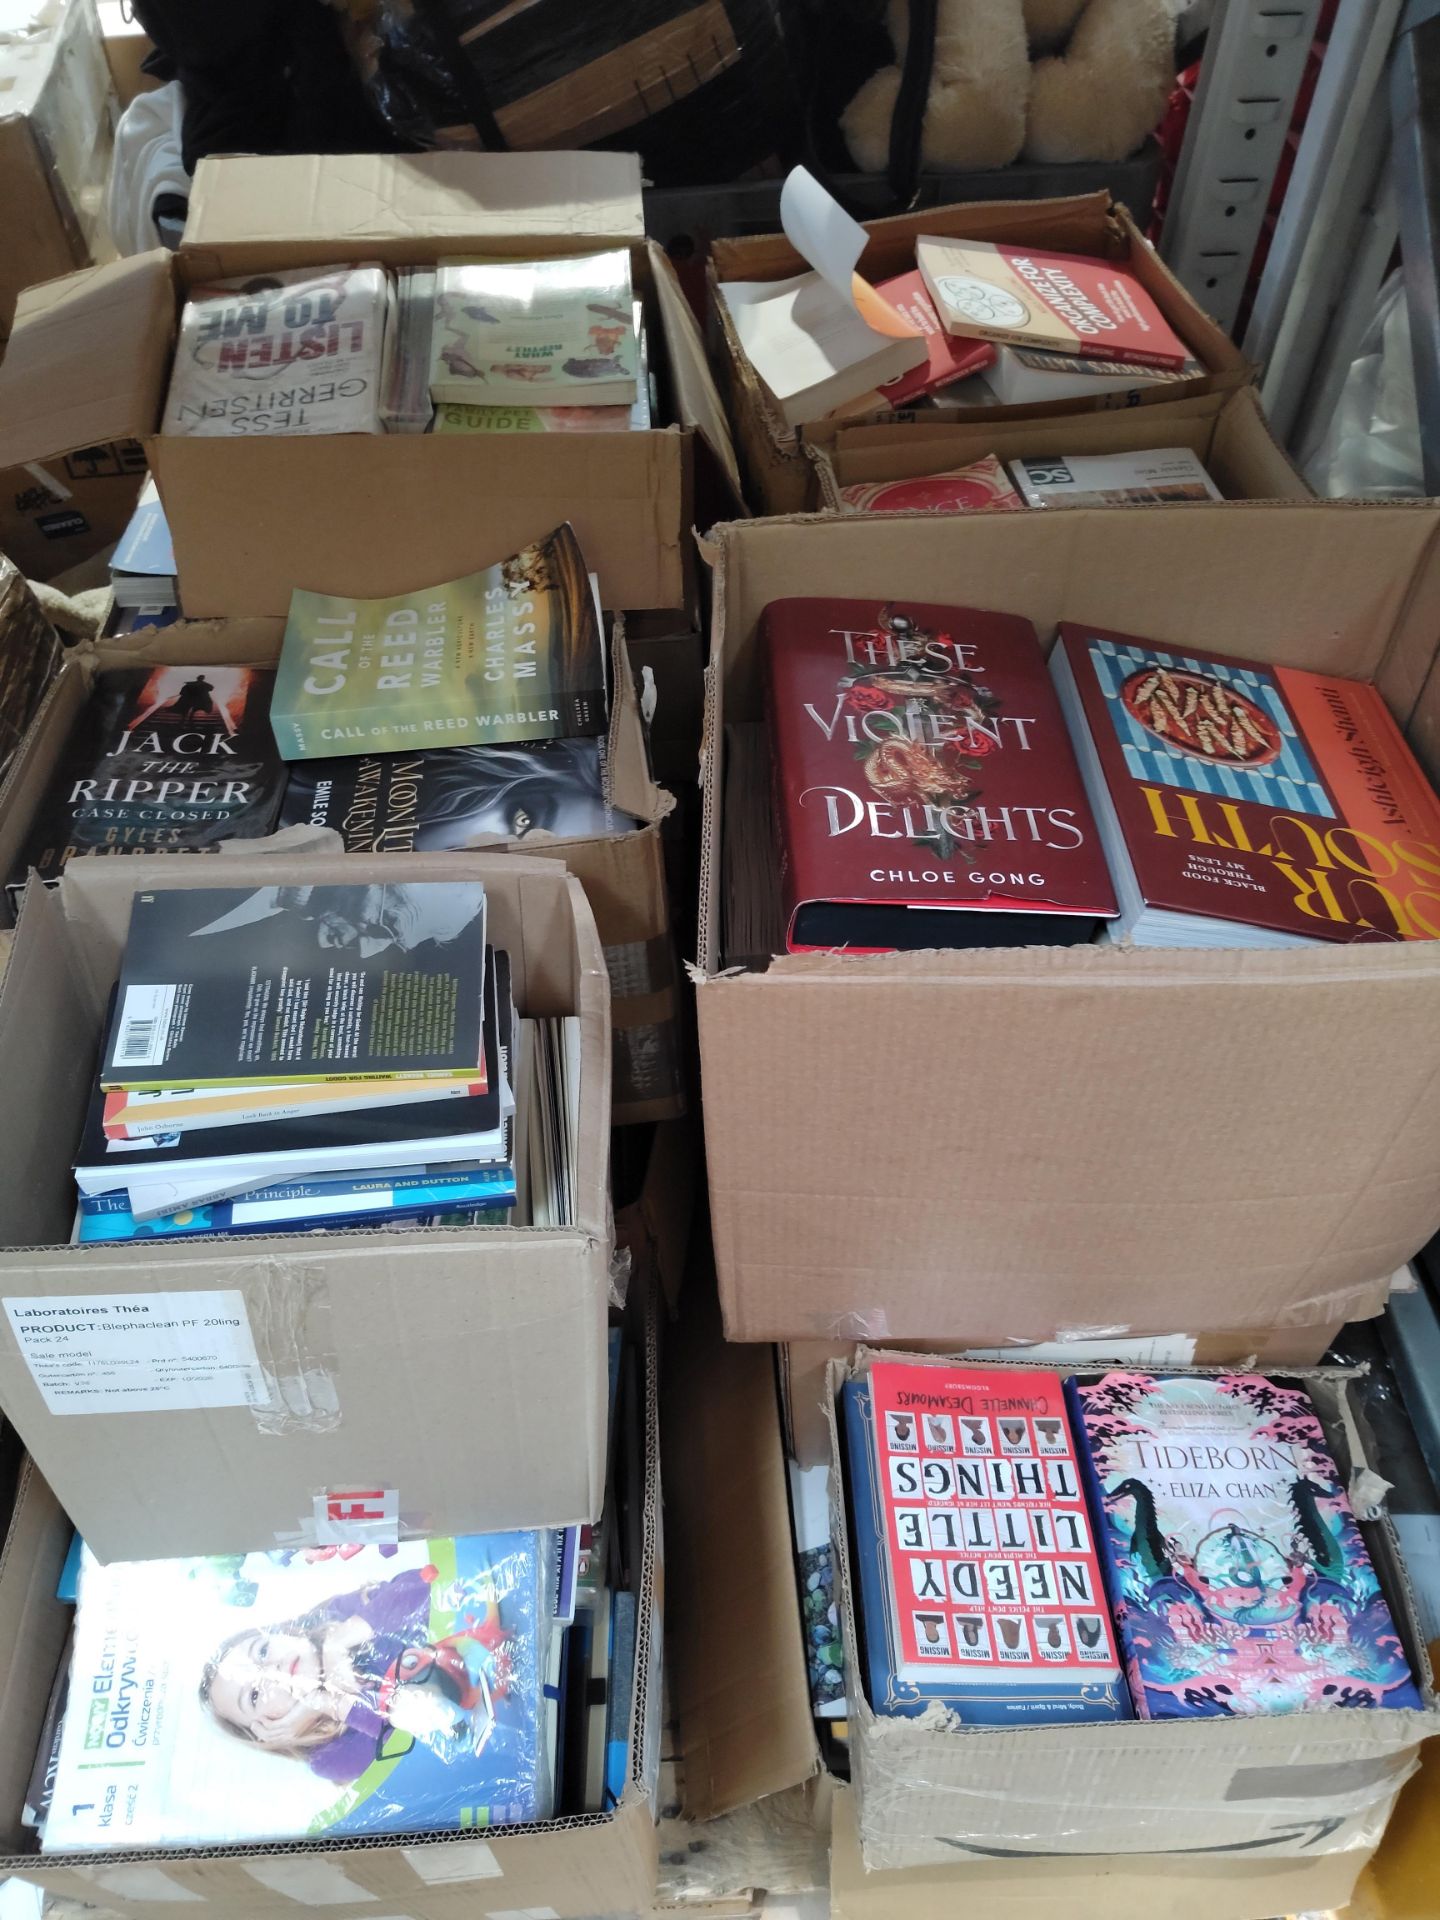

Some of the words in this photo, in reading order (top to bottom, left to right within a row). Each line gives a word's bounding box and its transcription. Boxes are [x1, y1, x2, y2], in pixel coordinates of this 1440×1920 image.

[1010, 256, 1037, 284] FOR
[1034, 275, 1099, 335] ORGANIZE
[1042, 266, 1118, 331] COMPLEXITY
[197, 303, 271, 343] ME
[284, 294, 336, 329] TO
[217, 320, 364, 373] LISTEN
[514, 350, 554, 359] WHAT
[176, 378, 367, 421] GERRITSEN
[232, 408, 309, 435] TESS
[443, 412, 532, 430] GUIDE
[1028, 468, 1071, 485] SC
[484, 587, 506, 682] CHARLES
[508, 579, 538, 679] MASSY
[304, 609, 357, 696] CALL
[359, 656, 370, 669] OF
[366, 633, 376, 653] THE
[376, 608, 420, 690] REED
[420, 601, 447, 689] WARBLER
[829, 628, 987, 674] THESE
[321, 727, 366, 740] CALL
[371, 726, 385, 736] OF
[391, 723, 417, 734] THE
[423, 717, 470, 732] REED
[474, 709, 560, 728] WARBLER
[803, 692, 1037, 752] VIOLENT
[106, 730, 240, 757] JACK
[295, 722, 306, 751] MASSY
[142, 760, 200, 774] THE
[67, 777, 252, 804] RIPPER
[313, 780, 332, 810] EMILE
[71, 808, 129, 819] CASE
[138, 809, 231, 821] CLOSED
[799, 785, 1084, 852] DELIGHTS
[105, 825, 183, 844] GYLES
[1139, 786, 1440, 890] SOUTH
[1188, 854, 1223, 867] LENS
[1188, 862, 1255, 882] THROUGH
[1227, 859, 1246, 871] MY
[869, 869, 956, 885] CHLOE
[968, 871, 1046, 887] GONG
[1182, 870, 1222, 885] FOOD
[1226, 878, 1267, 893] BLACK
[137, 1123, 153, 1132] John
[155, 1121, 184, 1130] Osborne
[352, 1182, 391, 1191] LAURA
[394, 1179, 419, 1188] AND
[422, 1175, 469, 1185] DUTTON
[90, 1199, 130, 1212] The
[244, 1184, 317, 1202] Principle
[14, 1306, 108, 1318] Laboratoires
[115, 1304, 150, 1314] Théa
[20, 1323, 102, 1334] PRODUCT:
[102, 1321, 179, 1332] Blephaclean
[182, 1319, 199, 1328] PF
[24, 1336, 53, 1344] Pack
[55, 1335, 70, 1343] 24
[30, 1352, 55, 1360] Sale
[58, 1350, 92, 1359] model
[944, 1382, 990, 1391] BLOOMSBURY
[896, 1391, 974, 1415] DESAMOURS
[981, 1395, 1049, 1415] CHANNELLE
[889, 1442, 917, 1451] MISSING
[965, 1446, 993, 1455] MISSING
[1002, 1447, 1031, 1455] MISSING
[1039, 1447, 1068, 1455] MISSING
[1127, 1440, 1300, 1470] TIDEBORN
[896, 1462, 1078, 1498] THINGS
[1169, 1482, 1220, 1498] ELIZA
[1225, 1483, 1278, 1499] CHAN
[898, 1511, 1082, 1549] LITTLE
[918, 1561, 1090, 1601] NEEDY
[919, 1646, 950, 1656] MISSING
[961, 1648, 990, 1658] MISSING
[1000, 1650, 1030, 1660] MISSING
[132, 1678, 155, 1748] Ćwiczenia
[127, 1783, 139, 1792] 2
[72, 1802, 95, 1817] 1
[97, 1784, 118, 1828] klasa
